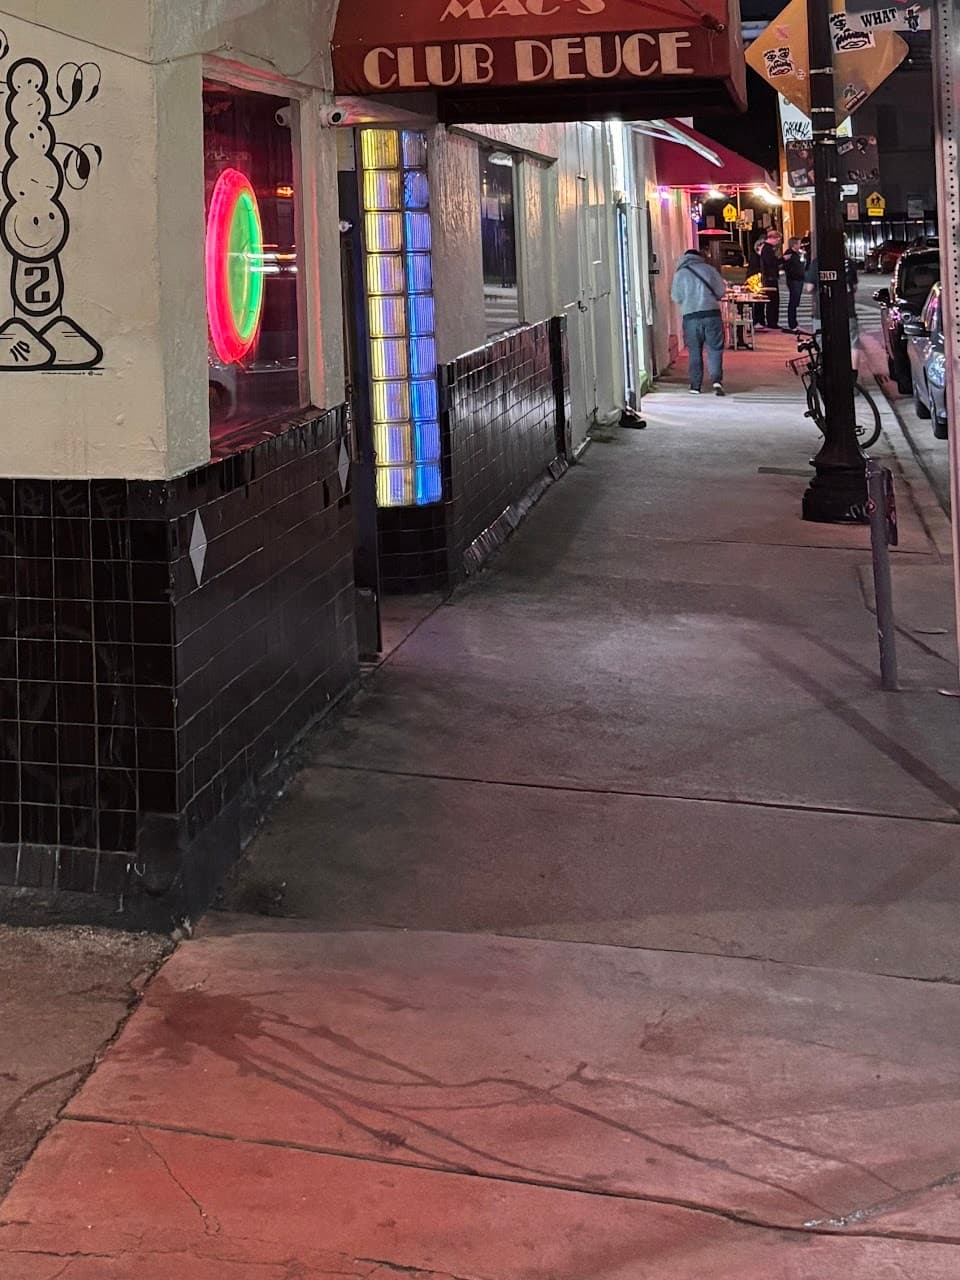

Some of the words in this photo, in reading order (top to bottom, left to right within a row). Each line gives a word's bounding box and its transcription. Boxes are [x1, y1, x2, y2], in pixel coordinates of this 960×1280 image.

[860, 8, 897, 28] WHAT
[363, 43, 494, 89] CLUB
[515, 32, 695, 82] DEUCE
[24, 266, 51, 304] 2
